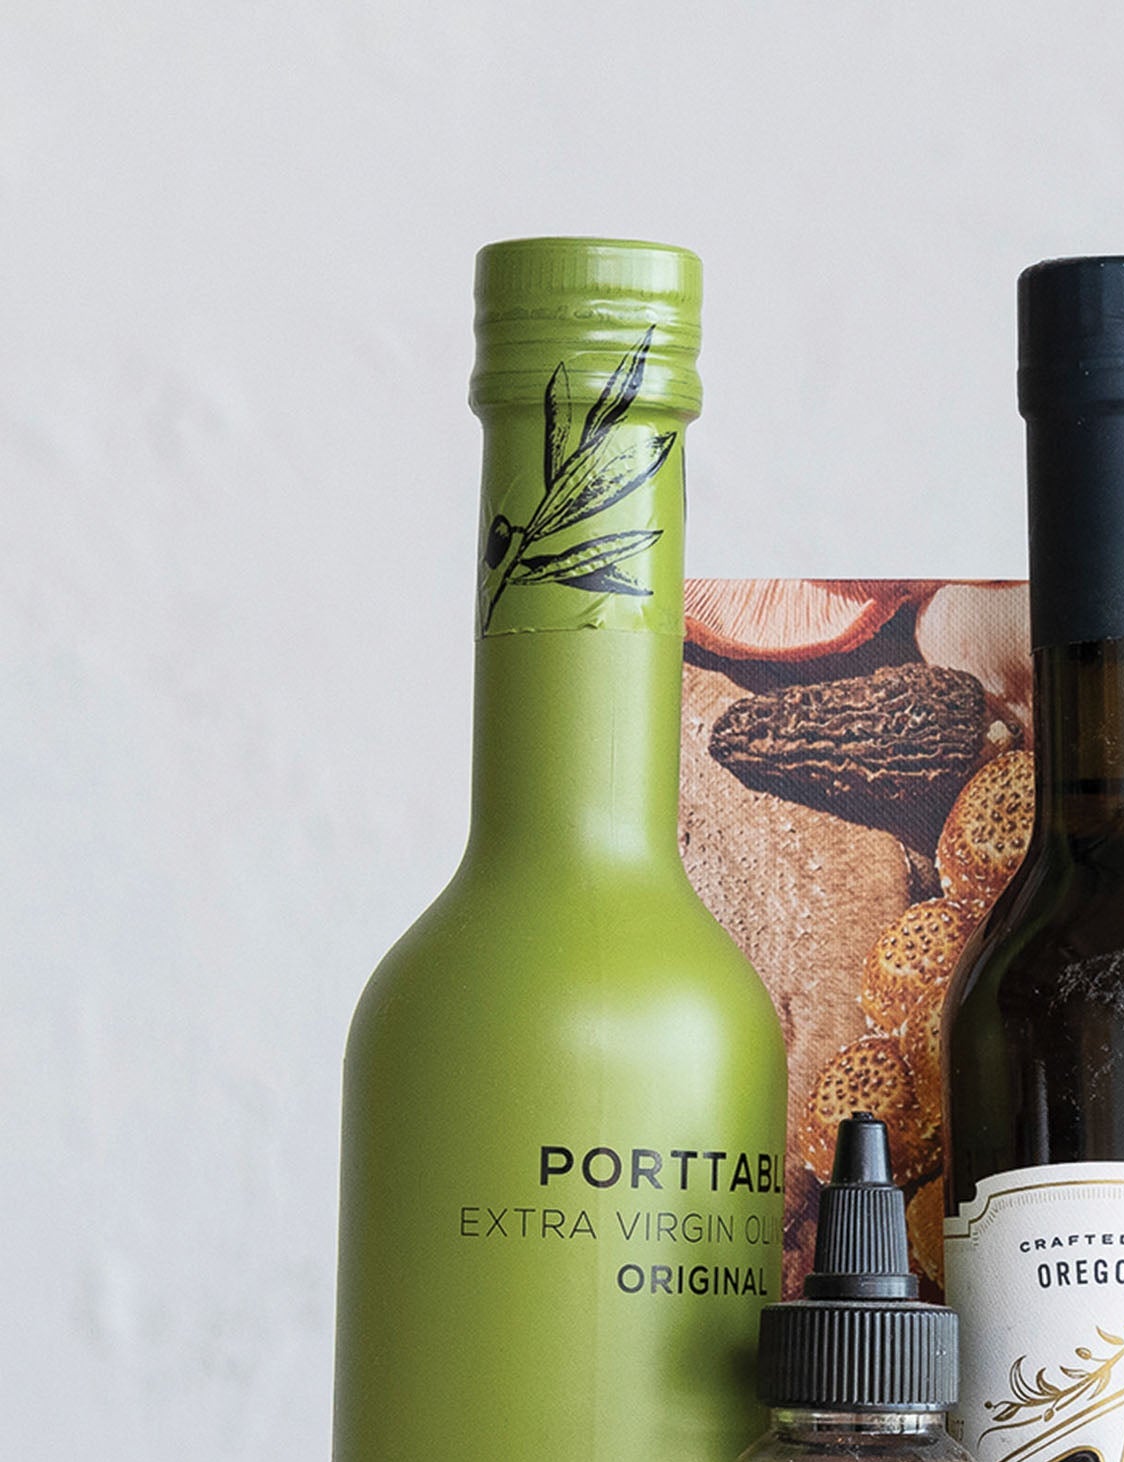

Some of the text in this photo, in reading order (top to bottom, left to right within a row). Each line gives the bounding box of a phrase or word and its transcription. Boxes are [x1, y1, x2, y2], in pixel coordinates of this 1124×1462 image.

[460, 1207, 597, 1240] EXTRA
[616, 1211, 734, 1244] VIRGIN
[617, 1264, 768, 1297] ORIGINAL
